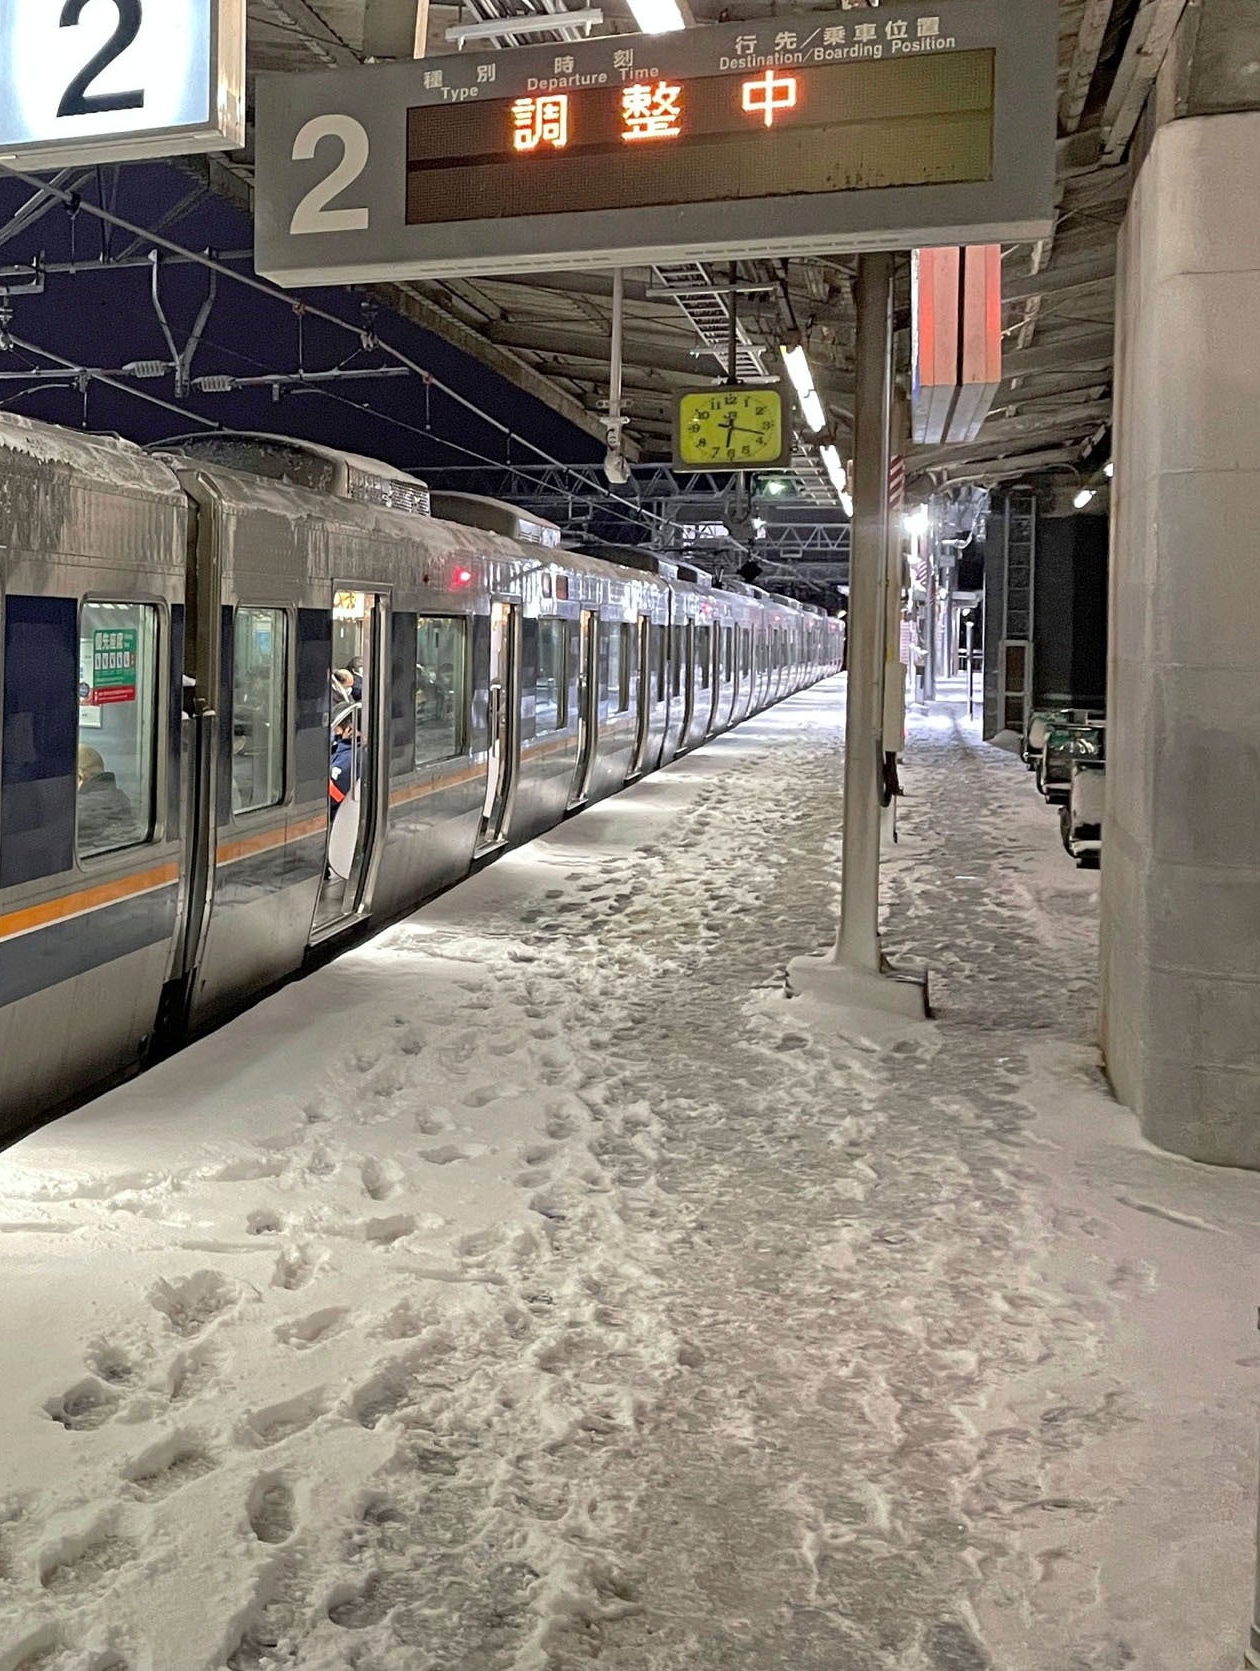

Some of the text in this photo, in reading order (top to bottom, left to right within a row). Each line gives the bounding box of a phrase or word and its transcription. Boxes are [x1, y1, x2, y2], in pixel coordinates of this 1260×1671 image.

[891, 35, 956, 54] Position
[57, 0, 145, 118] 2
[527, 65, 660, 92] Departure Time
[441, 85, 479, 101] Type
[289, 113, 370, 235] 2
[697, 411, 710, 420] 10
[756, 407, 764, 416] 2
[691, 424, 700, 433] 9
[762, 421, 771, 430] 3
[712, 447, 720, 458] 7
[727, 449, 735, 458] 6
